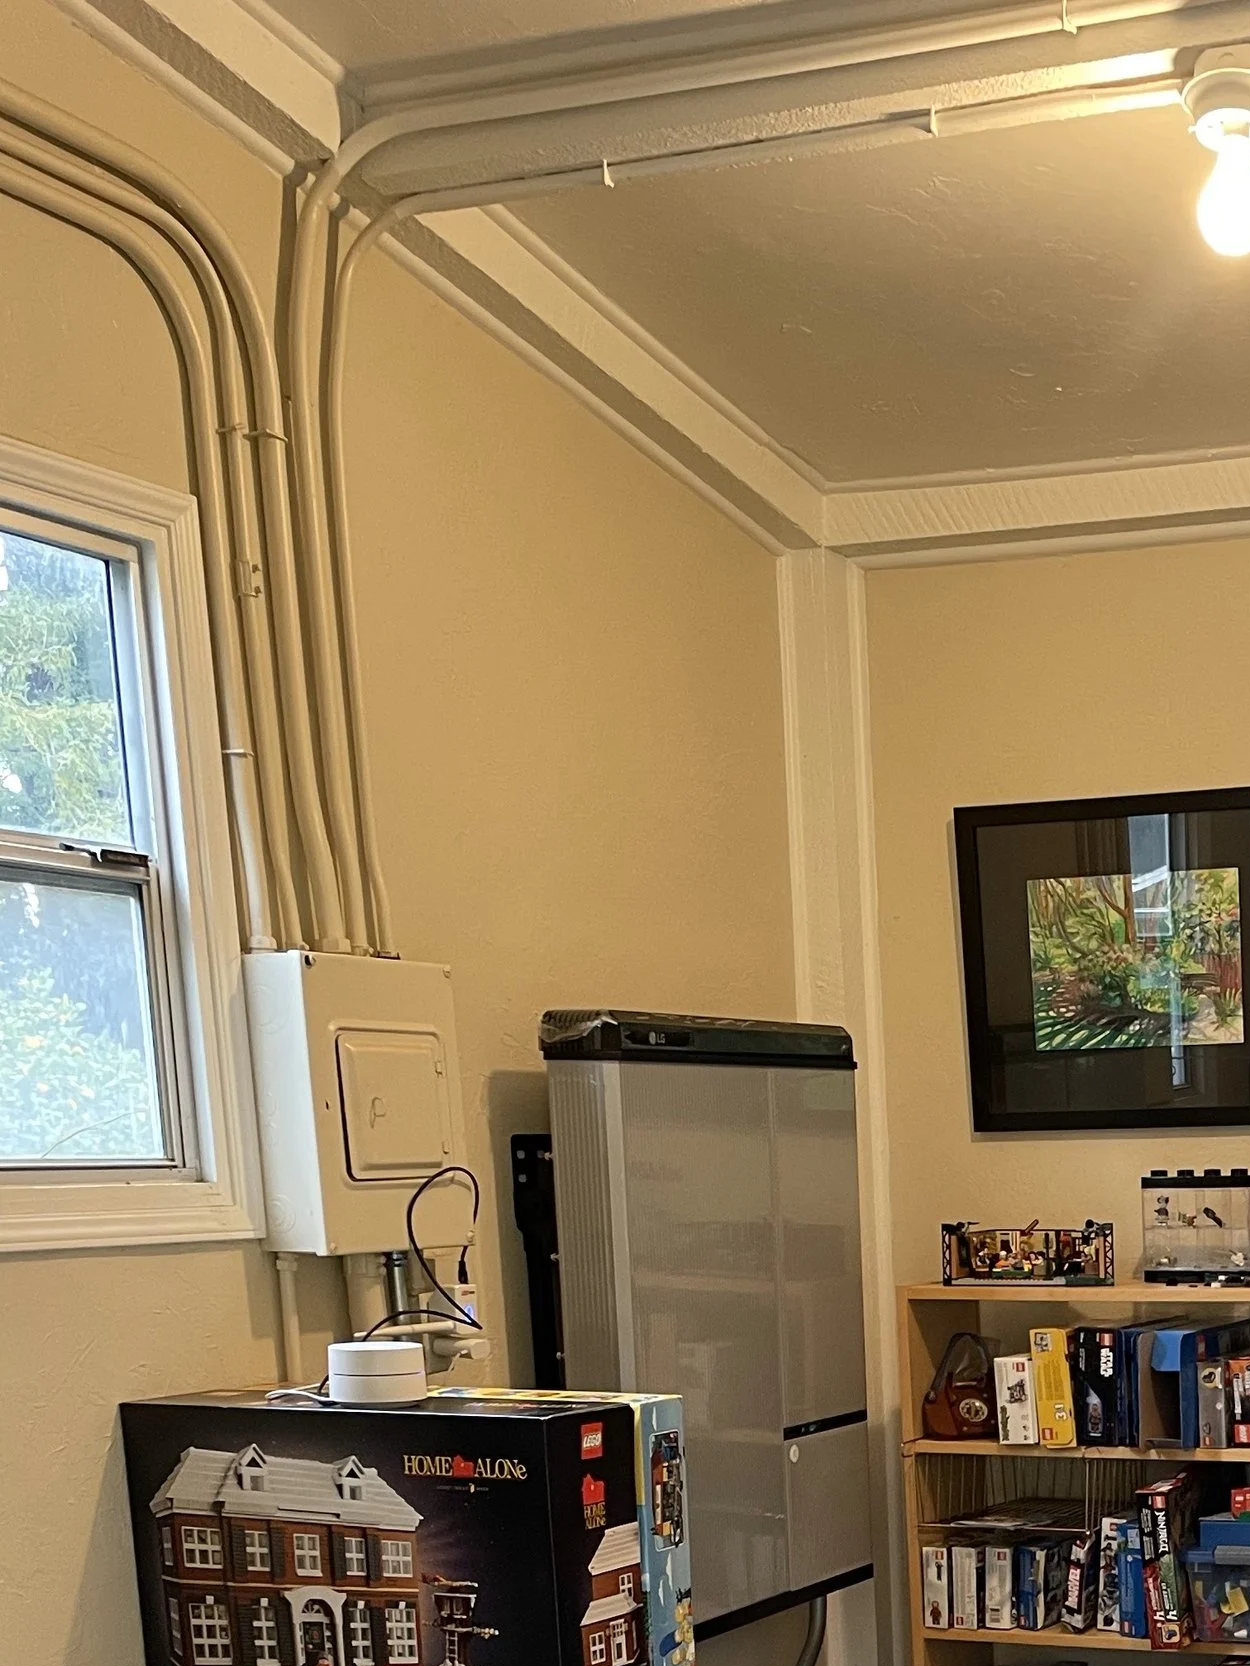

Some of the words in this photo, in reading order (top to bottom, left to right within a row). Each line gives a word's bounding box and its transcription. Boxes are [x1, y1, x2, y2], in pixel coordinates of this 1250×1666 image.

[657, 1033, 666, 1044] LG
[1100, 1348, 1108, 1376] WARS
[583, 1434, 601, 1447] LEGO
[403, 1455, 453, 1476] HOME
[584, 1503, 606, 1518] HOME
[1155, 1511, 1168, 1554] NINJAGO
[1068, 1566, 1080, 1602] MARVEL
